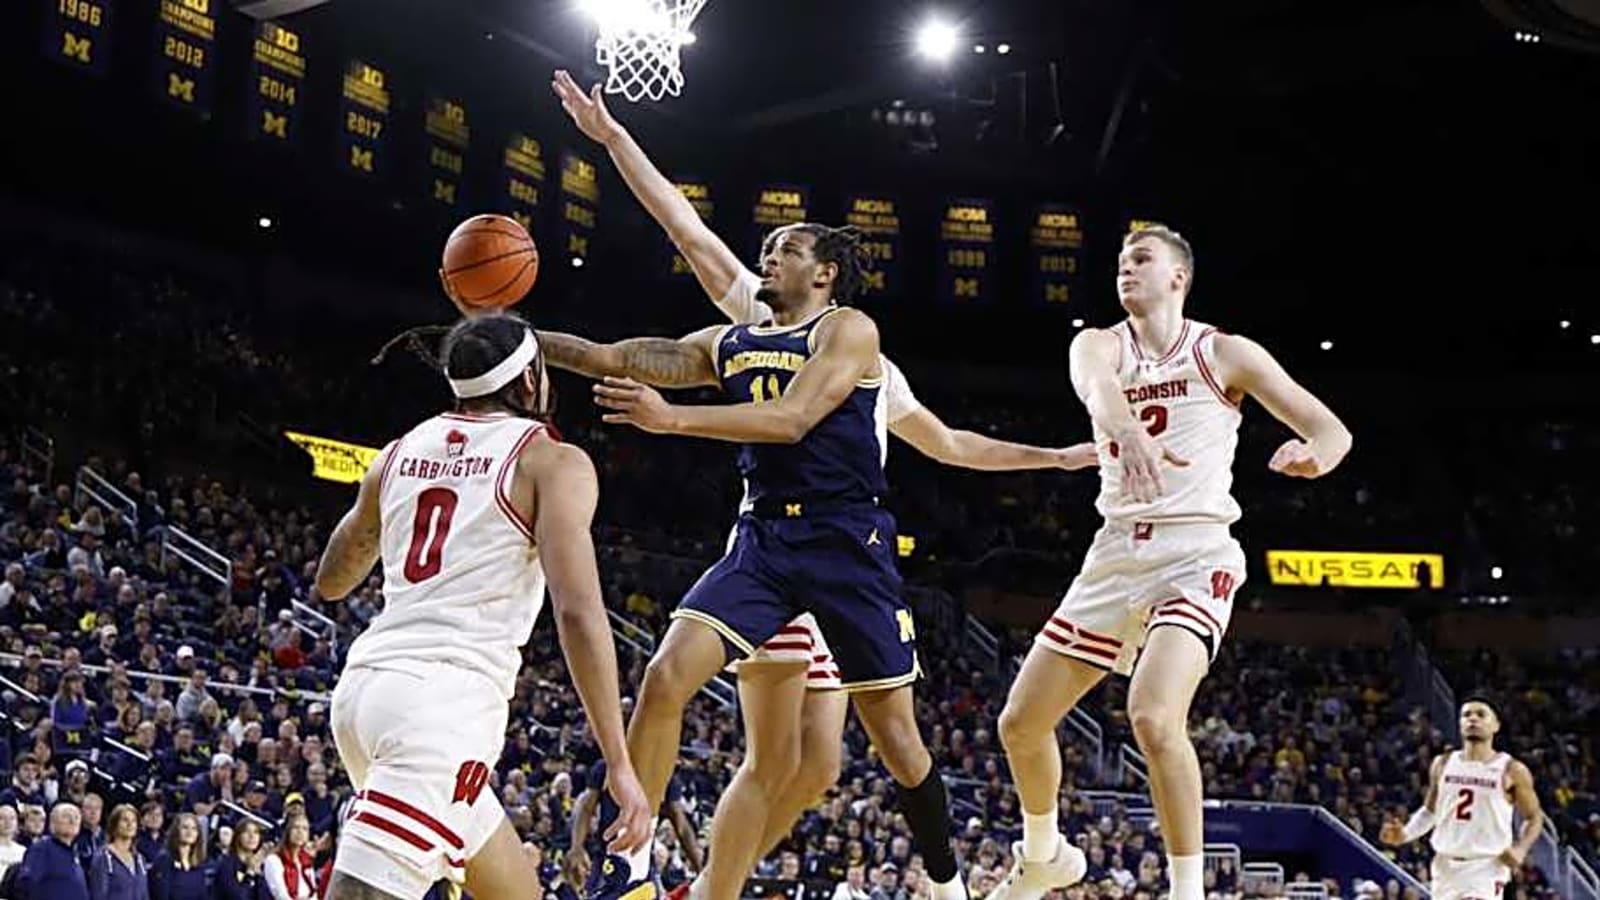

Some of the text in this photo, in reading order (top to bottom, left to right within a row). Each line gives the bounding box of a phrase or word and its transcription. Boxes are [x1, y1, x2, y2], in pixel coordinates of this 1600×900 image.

[259, 75, 296, 106] 2014
[1123, 379, 1188, 404] CONSIN
[404, 487, 458, 585] 0
[1277, 558, 1428, 581] NISSA
[1456, 788, 1474, 821] 2
